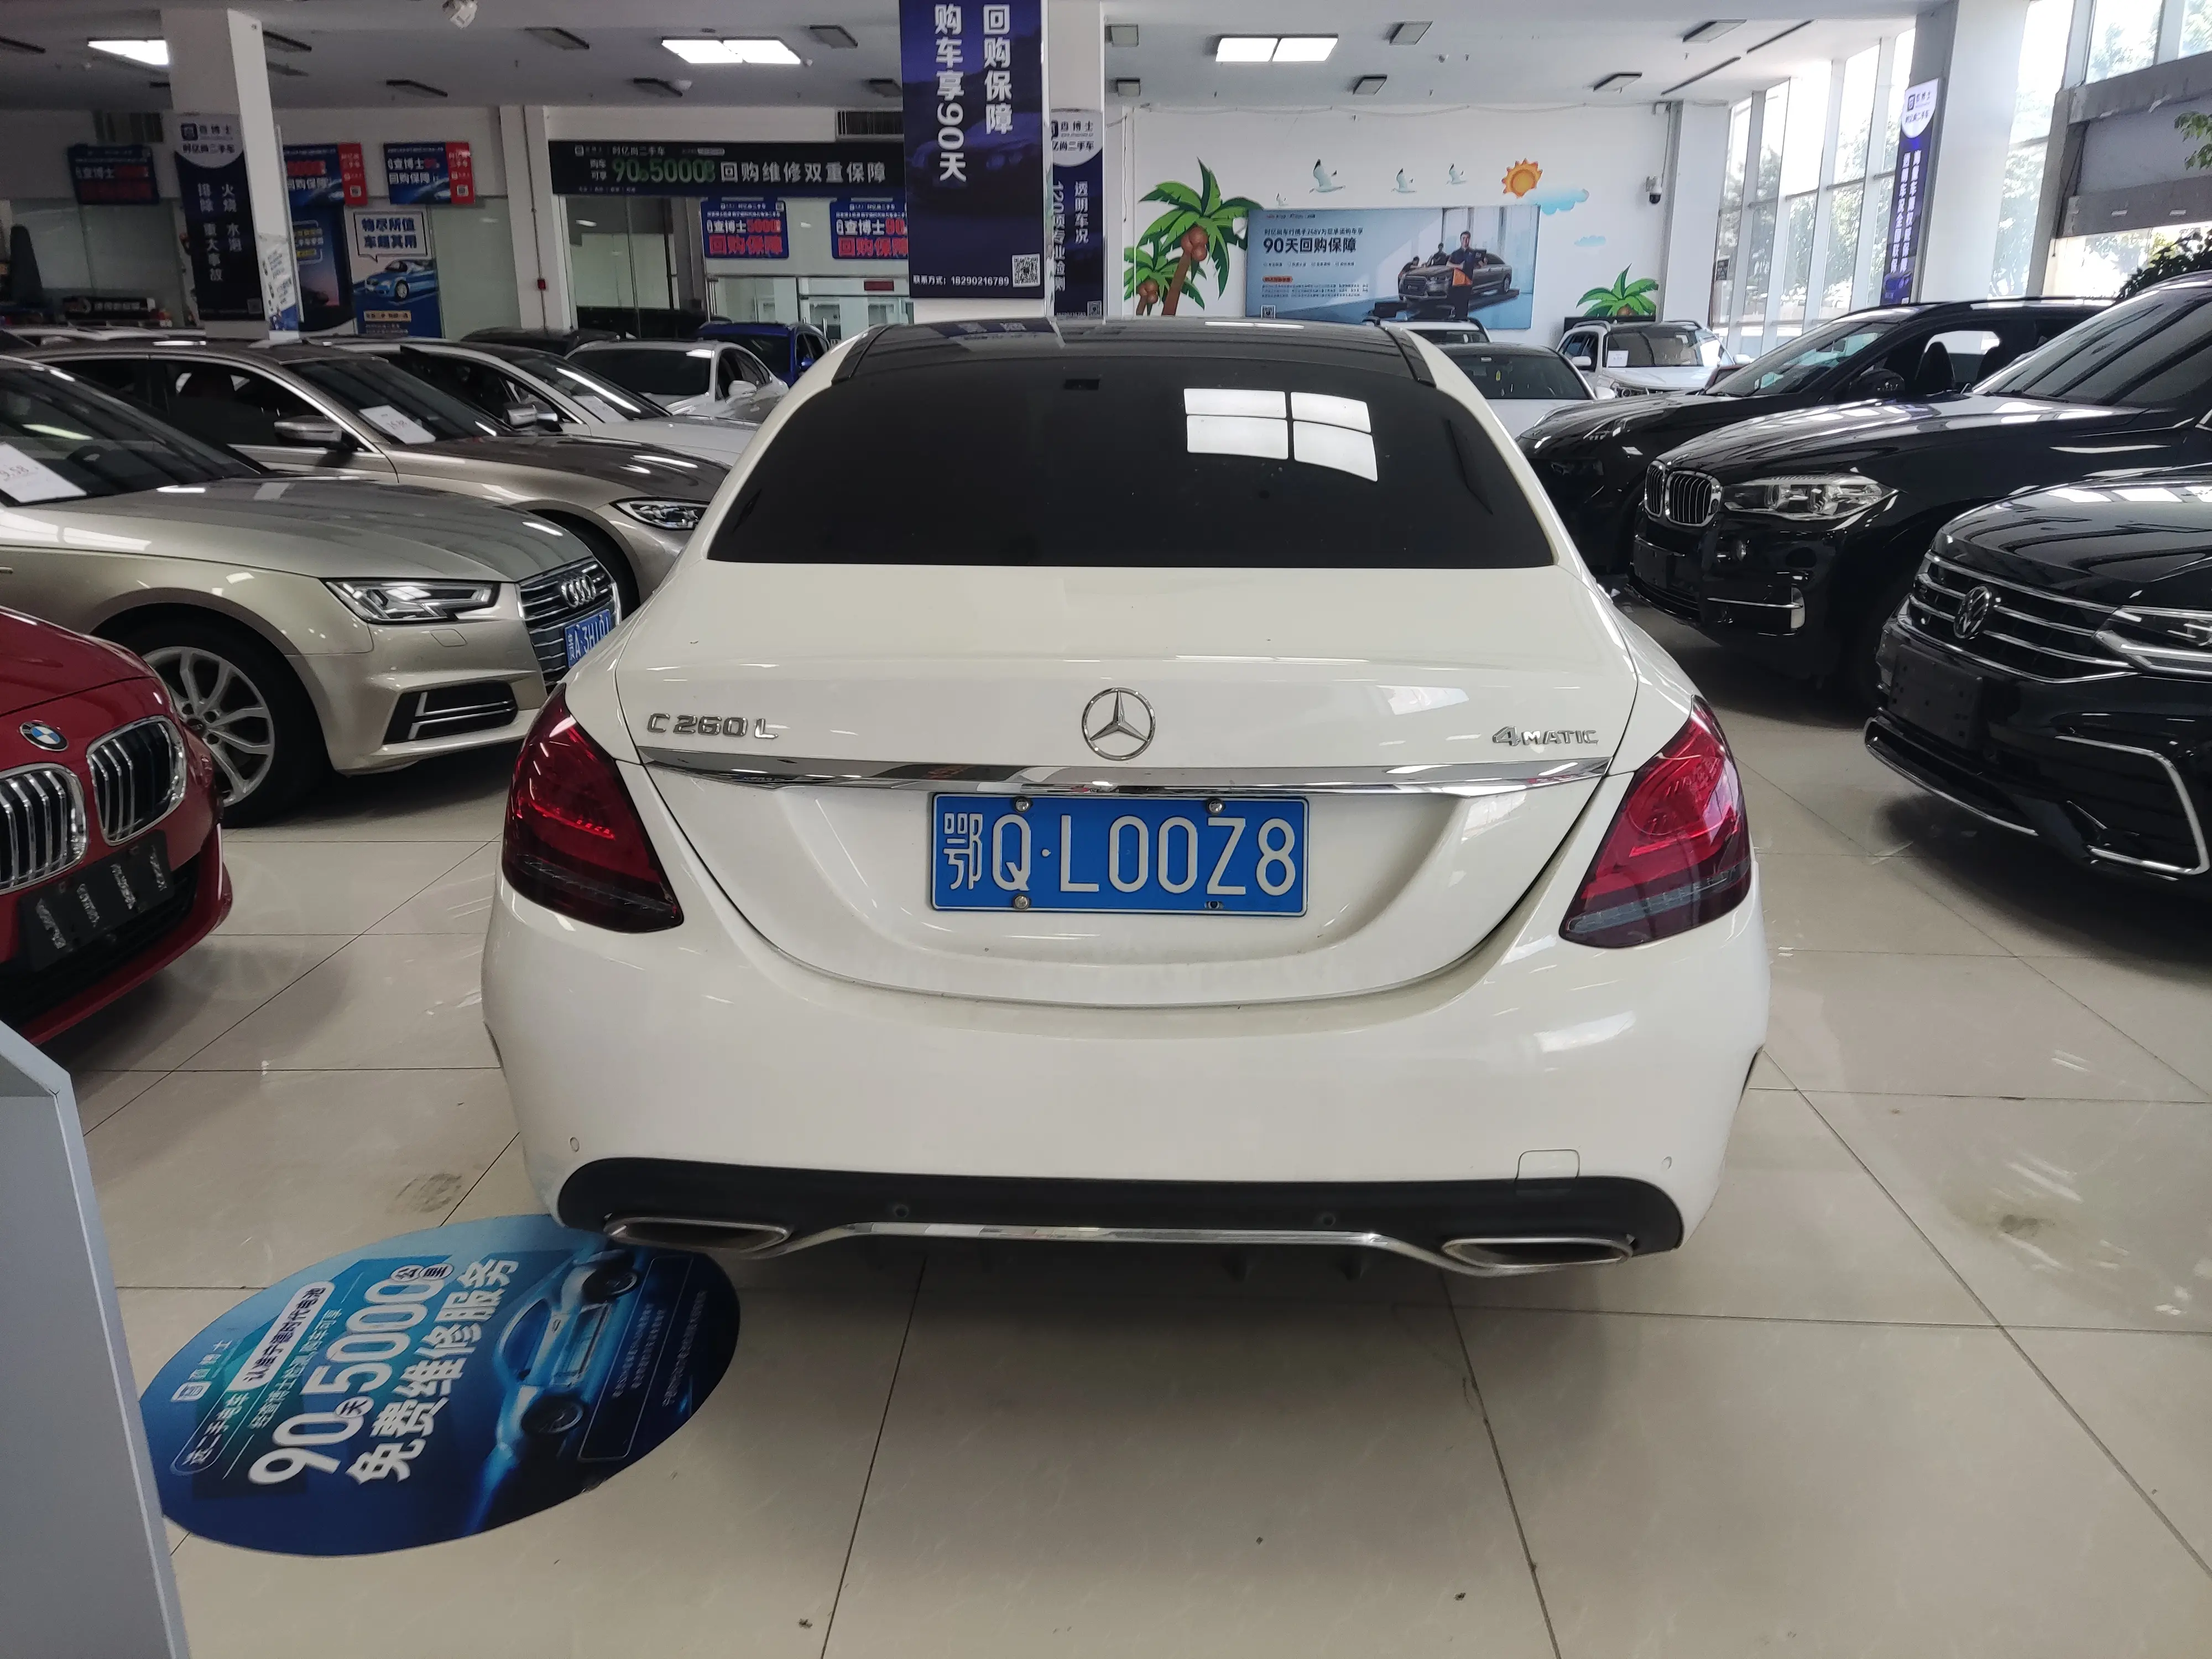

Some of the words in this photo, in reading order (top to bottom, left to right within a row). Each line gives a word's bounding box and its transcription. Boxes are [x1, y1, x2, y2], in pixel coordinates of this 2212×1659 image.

[983, 3, 1013, 135] 回购保障
[935, 3, 967, 183] 购车享90天
[1061, 121, 1094, 132] 查博士
[612, 145, 666, 156] 时亿尚二手车
[612, 158, 716, 183] 905000
[721, 161, 885, 182] 回购维修双重保障
[1074, 180, 1089, 244] 透明车况
[203, 222, 223, 281] 重大事故
[708, 234, 783, 255] 回购保障
[838, 237, 908, 257] 回购保障
[1263, 237, 1357, 254] 90天回购保障
[951, 276, 1010, 286] 18290216789
[1493, 726, 1599, 746] 4MATIC
[942, 812, 1296, 896] 鄂Q·L00Z8
[181, 1391, 250, 1465] 选二手电车
[242, 1286, 327, 1383] 认准宁德时代电池
[345, 1259, 520, 1485] 免费维修服务
